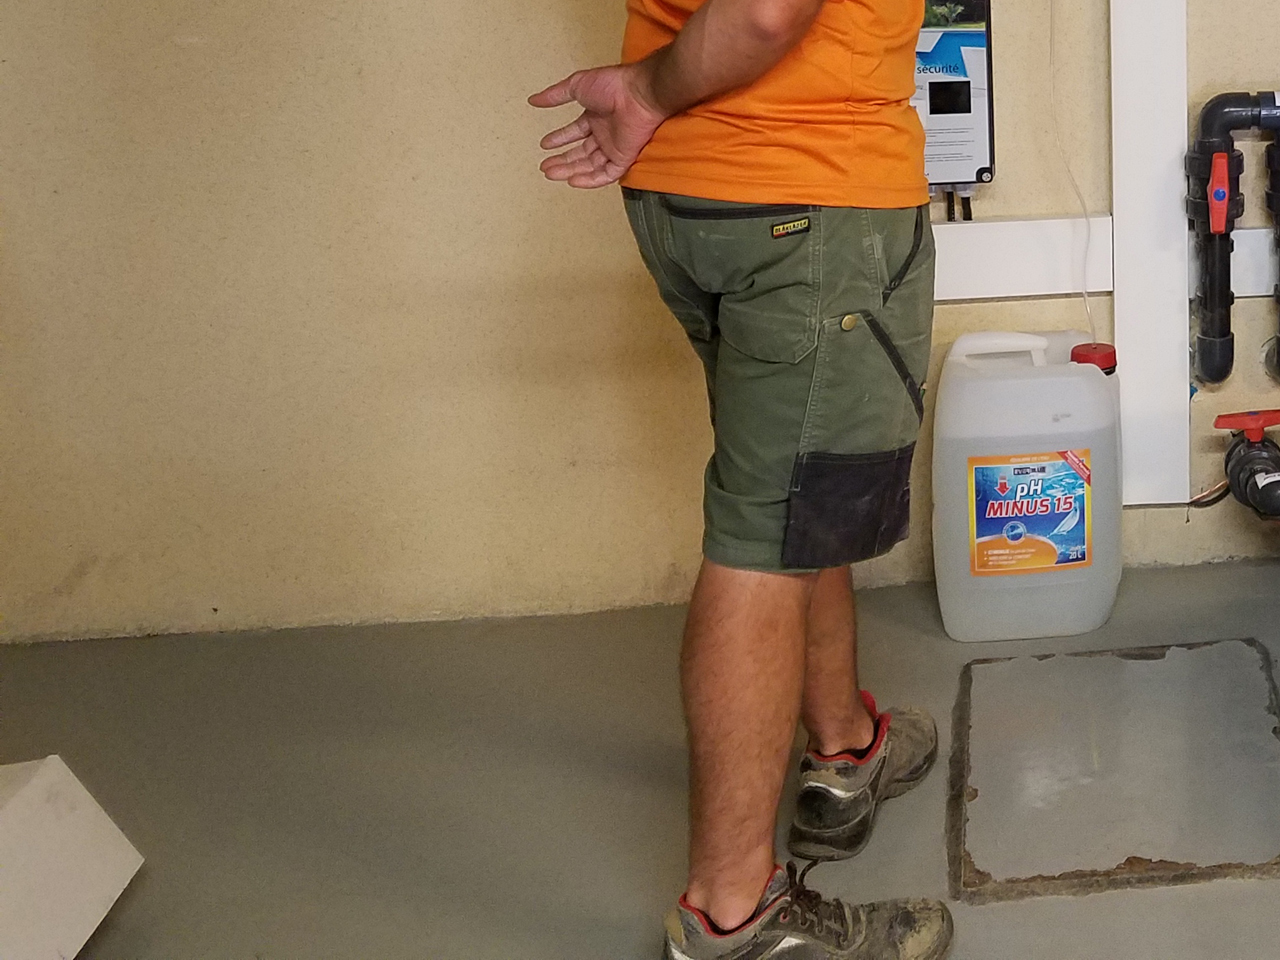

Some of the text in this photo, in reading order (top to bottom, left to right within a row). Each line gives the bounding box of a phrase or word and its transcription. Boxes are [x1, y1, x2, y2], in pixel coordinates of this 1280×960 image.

[916, 63, 960, 74] sécurité
[1016, 479, 1043, 501] pH
[986, 495, 1074, 518] MINUS 15
